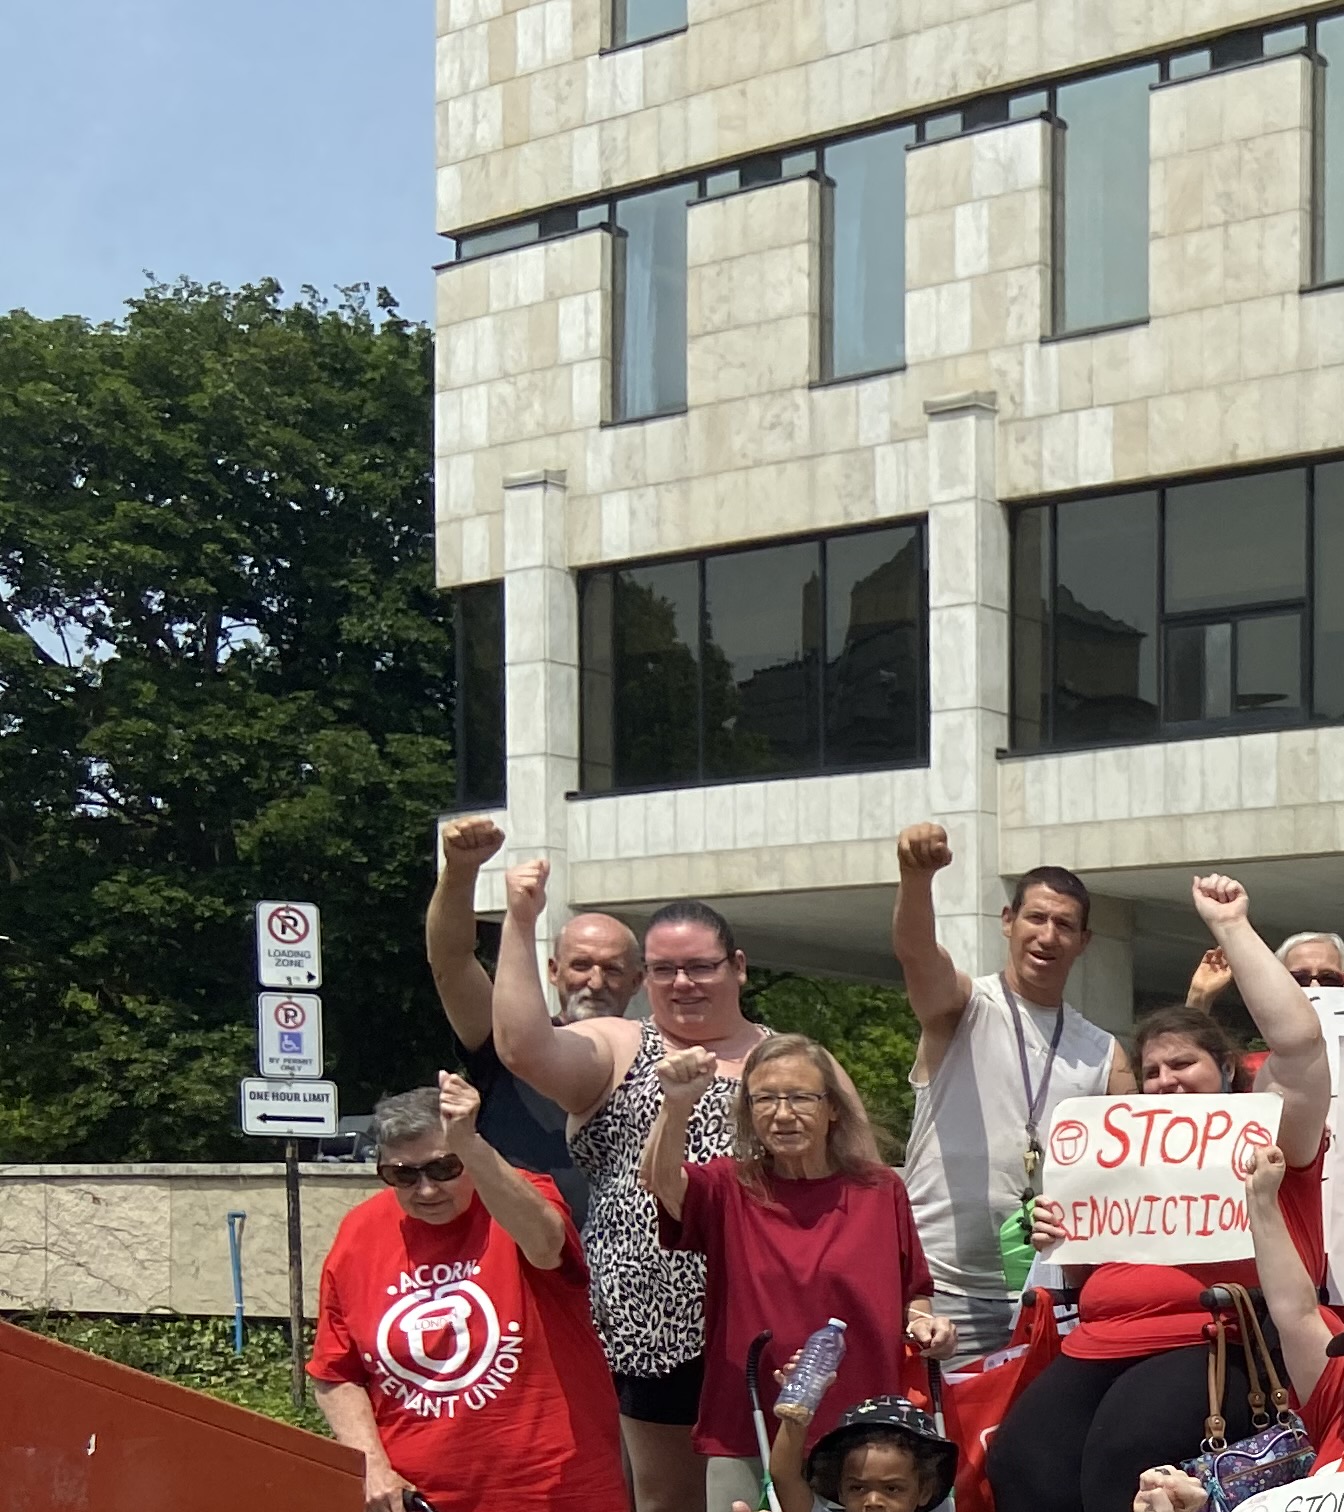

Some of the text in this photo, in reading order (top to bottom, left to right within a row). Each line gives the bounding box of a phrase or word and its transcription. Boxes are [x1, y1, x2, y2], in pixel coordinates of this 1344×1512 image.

[267, 949, 311, 959] LOADING
[275, 959, 304, 968] ZONE
[269, 1057, 313, 1066] BY PERMIT
[249, 1091, 330, 1103] ONE HOUR LIMIT
[1096, 1102, 1233, 1170] STOP
[1048, 1193, 1251, 1241] RENOVICTION
[400, 1260, 476, 1294] ACORN
[374, 1334, 524, 1419] TENANT UNION
